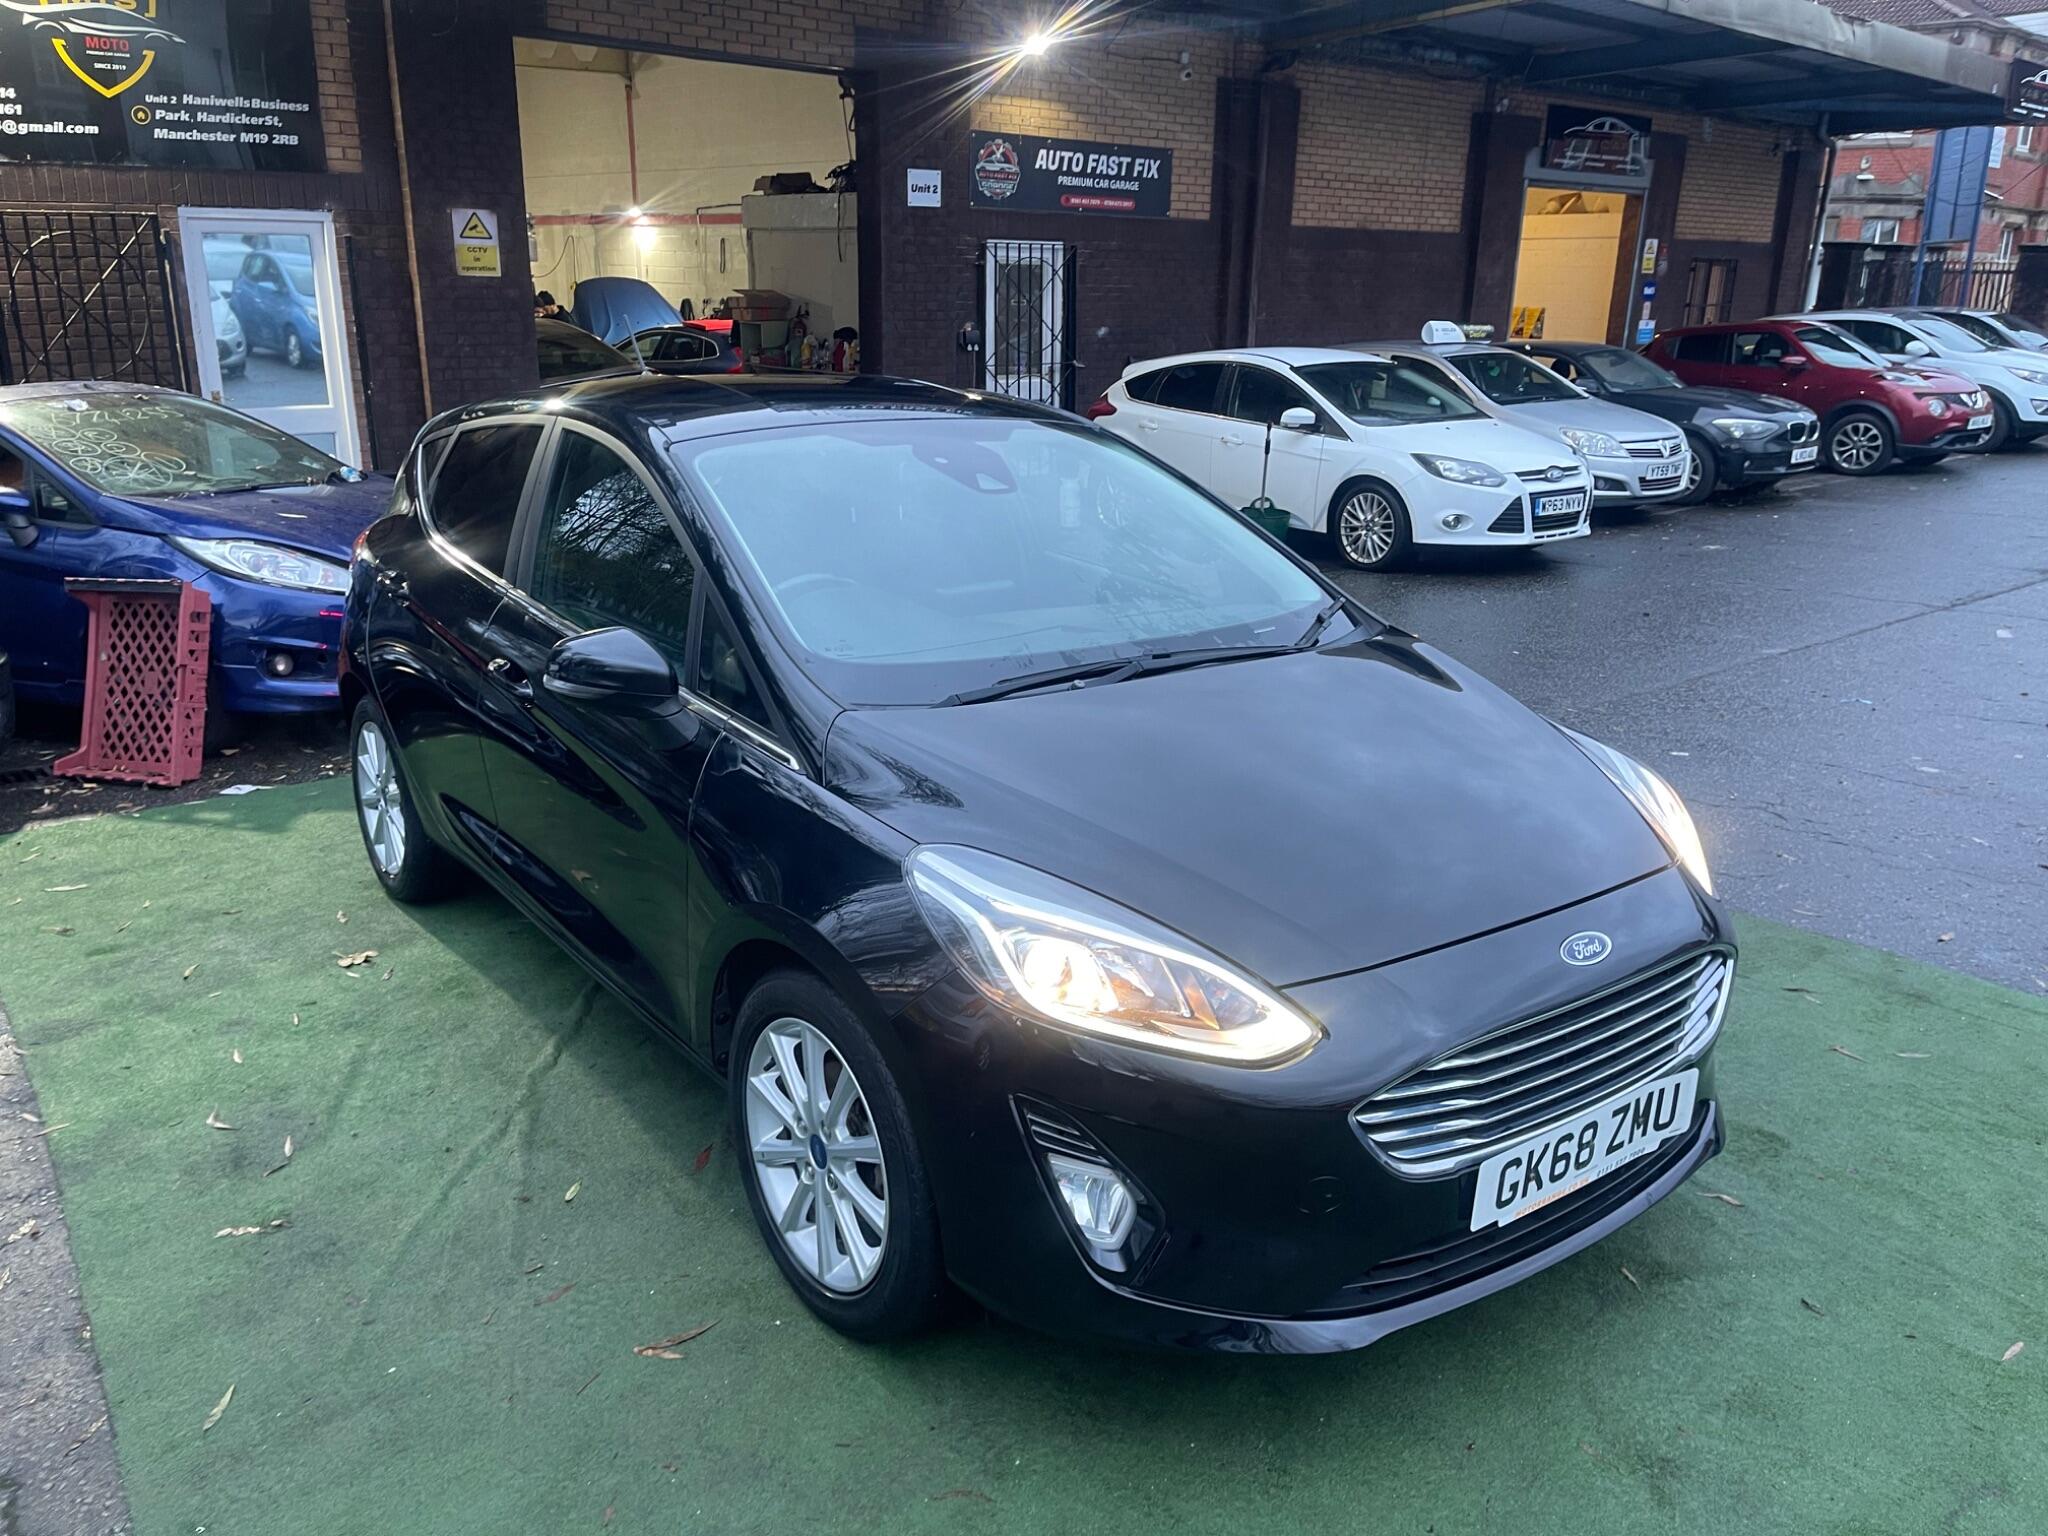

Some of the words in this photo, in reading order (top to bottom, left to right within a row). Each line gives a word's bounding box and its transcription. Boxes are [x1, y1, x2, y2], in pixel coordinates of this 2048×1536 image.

[85, 36, 129, 52] MOTO
[145, 94, 168, 104] Unit
[170, 96, 177, 104] 2
[0, 119, 99, 135] @gmail.com
[153, 128, 236, 142] Manchester
[240, 132, 268, 143] M19
[272, 134, 299, 145] 2RB
[1034, 148, 1084, 173] AUTO
[1086, 153, 1132, 177] FAST
[1132, 158, 1161, 179] FIX
[911, 183, 930, 193] Unit
[932, 184, 938, 194] 2
[1057, 175, 1093, 188] PREMIUM
[1094, 178, 1110, 189] CAR
[1110, 180, 1140, 191] GARAGE
[1572, 938, 1602, 960] Ford
[1495, 1120, 1599, 1210] GK68
[1605, 1082, 1681, 1157] ZMU
